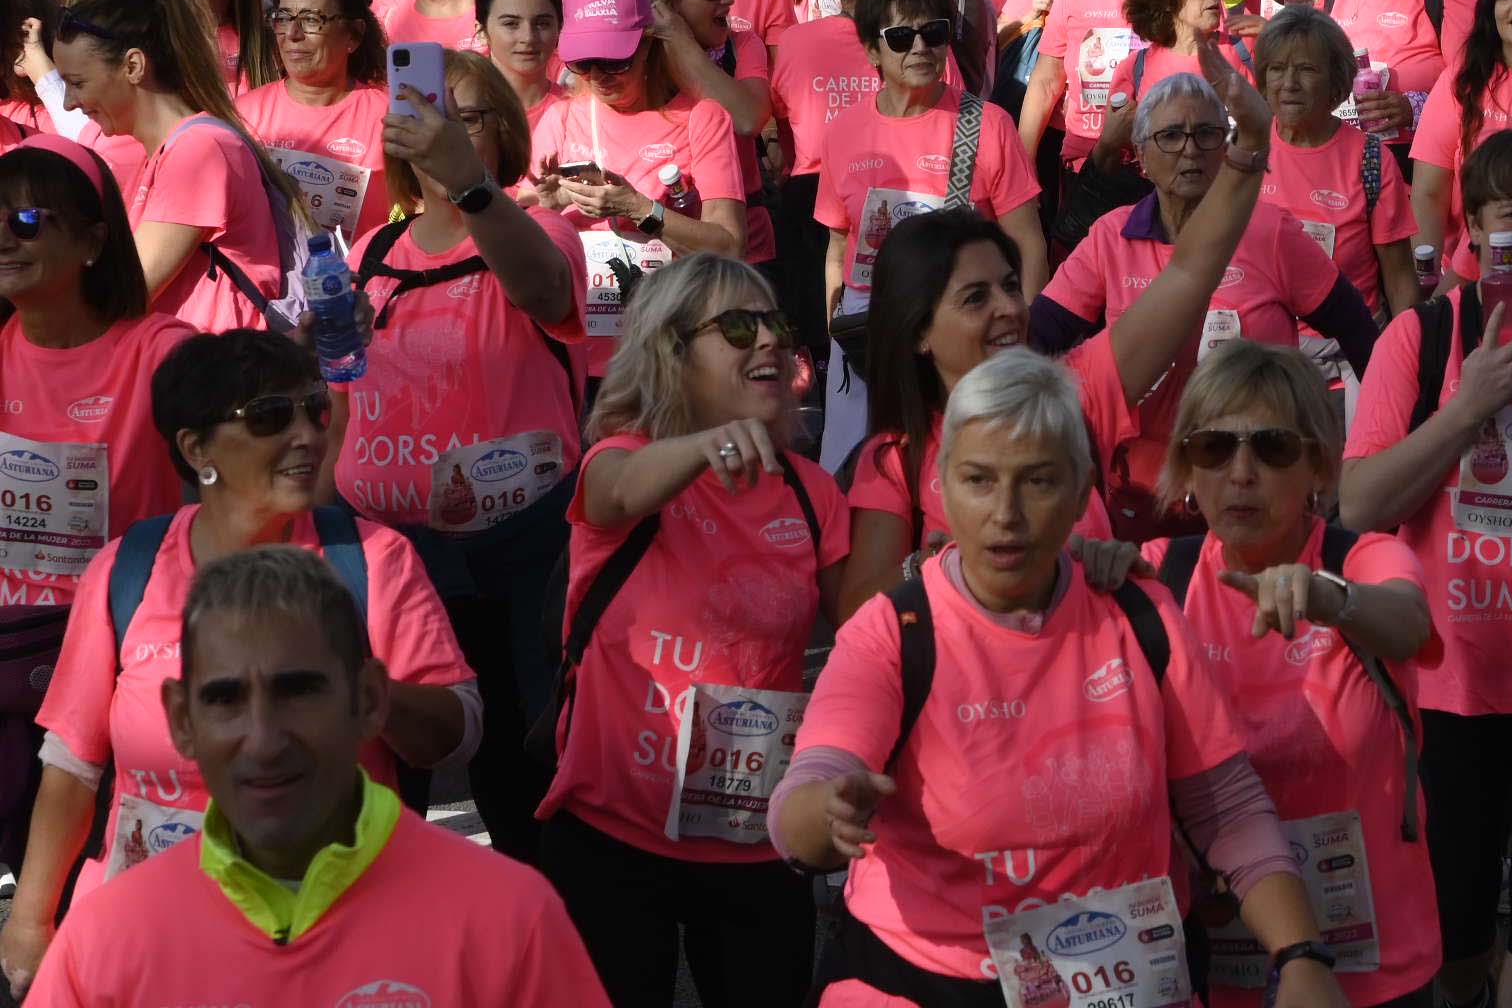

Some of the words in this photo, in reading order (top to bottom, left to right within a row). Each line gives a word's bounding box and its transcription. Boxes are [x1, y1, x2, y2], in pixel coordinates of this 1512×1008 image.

[829, 93, 851, 107] DE
[355, 392, 381, 420] TU
[0, 457, 55, 478] ASTURIANA
[67, 462, 97, 470] SUMA
[1, 490, 52, 512] 016
[354, 480, 432, 512] SUM
[482, 488, 526, 512] 016
[6, 515, 46, 529] 14224
[1468, 512, 1512, 528] OYSHO
[38, 535, 67, 544] MUJER
[651, 630, 703, 672] TU
[714, 712, 773, 731] ASTURIANA
[710, 747, 764, 773] 016
[132, 769, 182, 801] TU
[709, 776, 751, 792] 18779
[1314, 833, 1349, 849] SUMA
[975, 848, 1035, 886] TU
[1130, 902, 1166, 920] SUMA
[1054, 926, 1121, 951] ASTURIANA
[1072, 960, 1135, 994] 016
